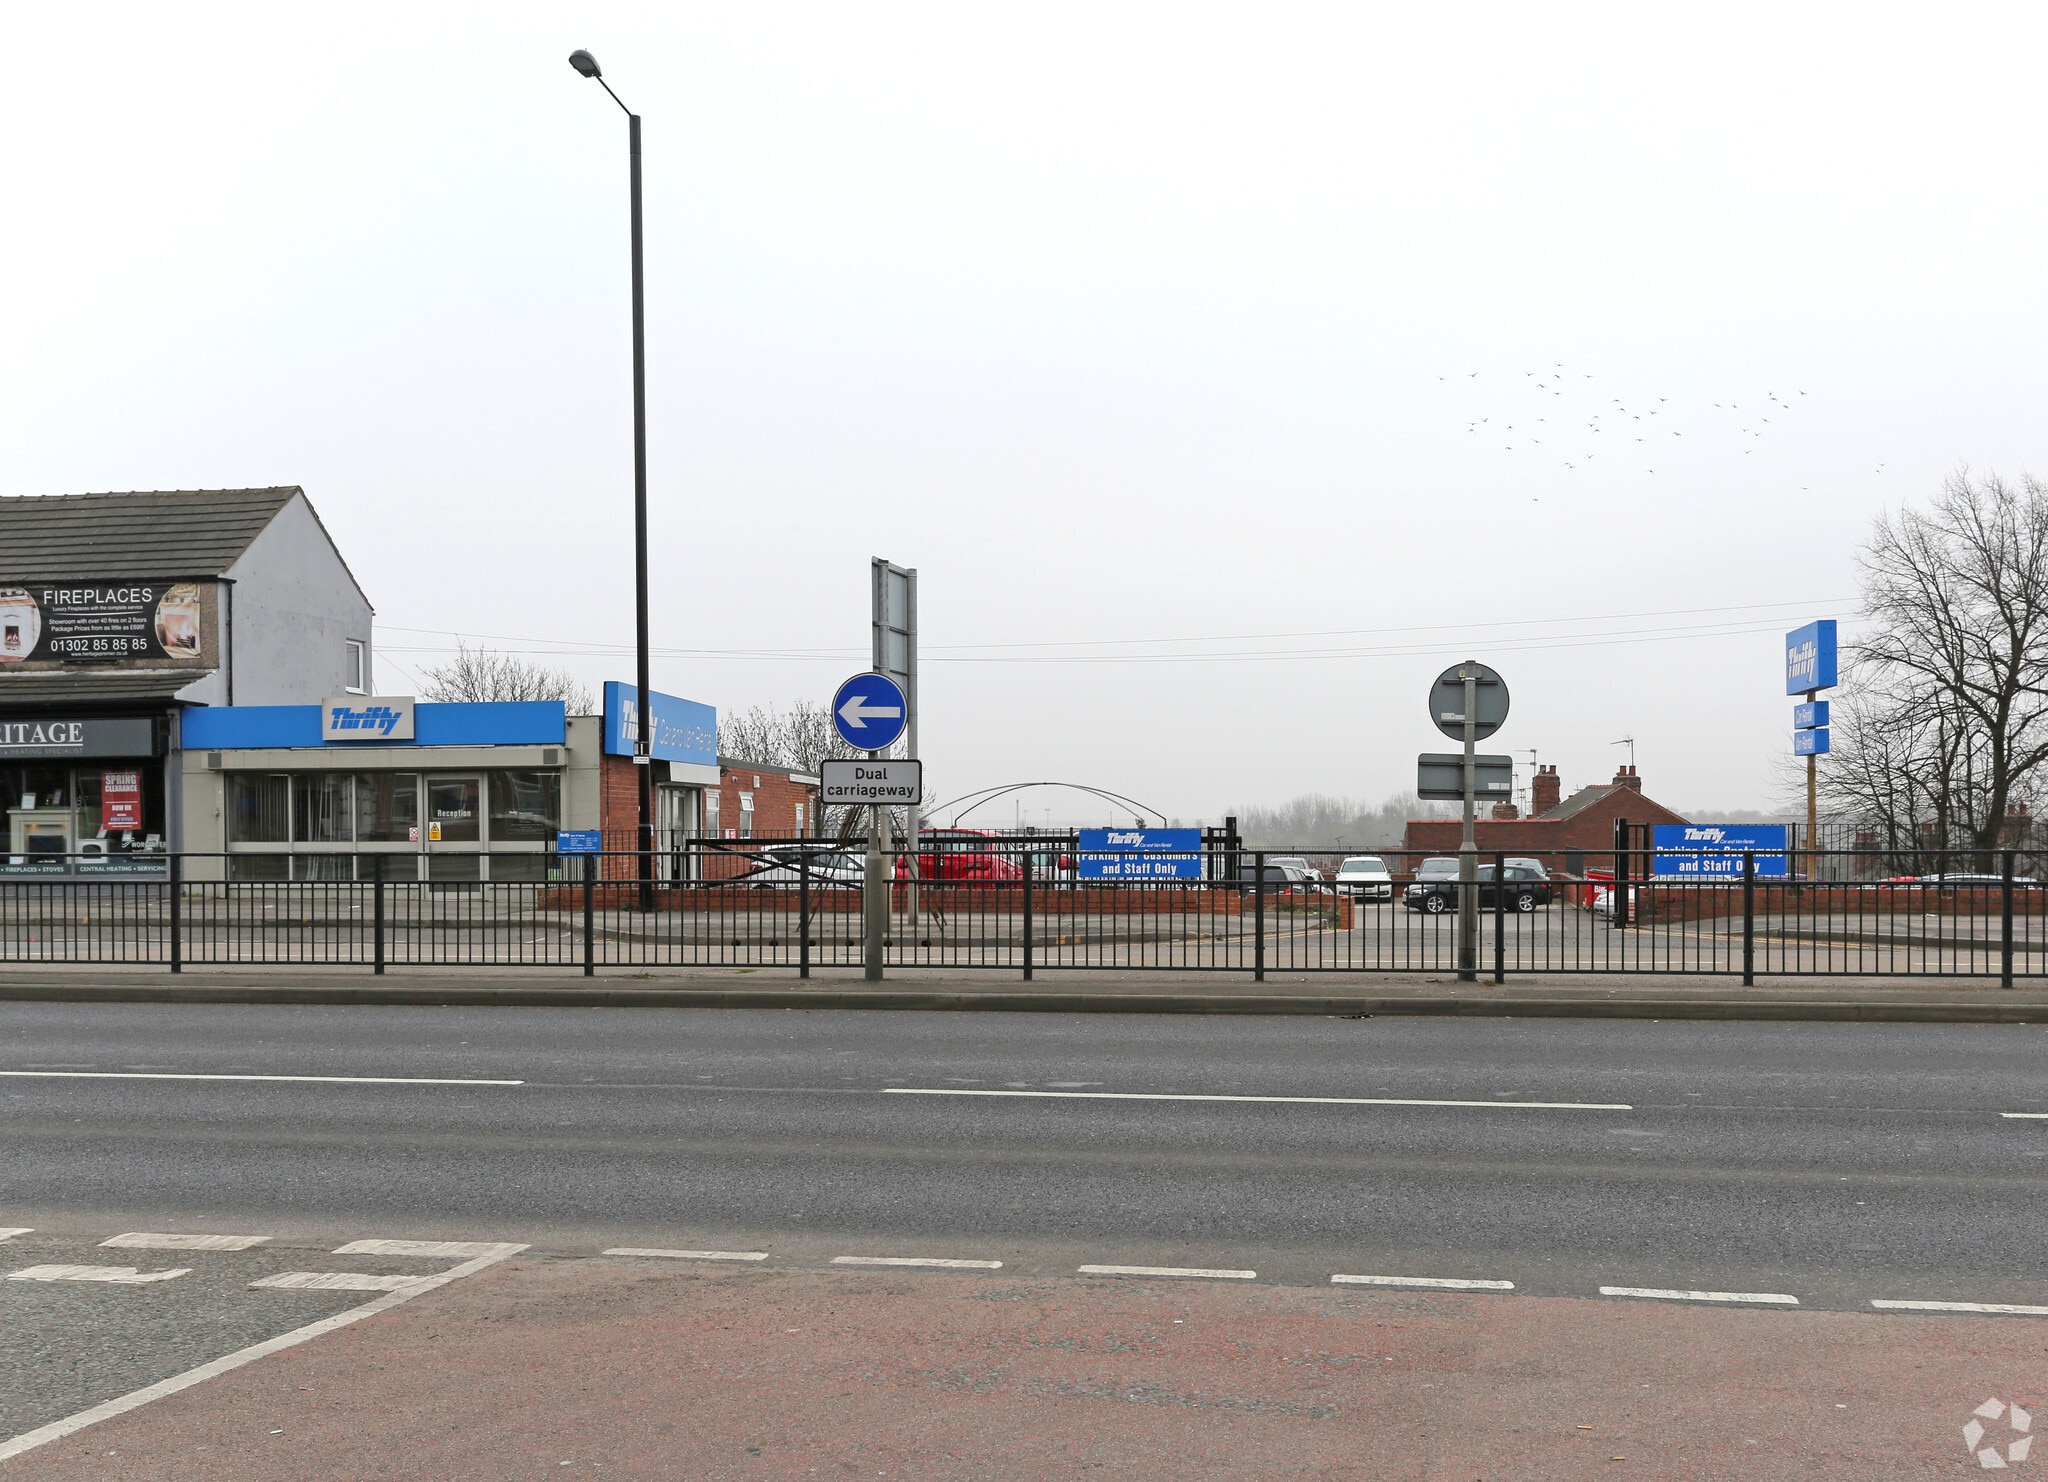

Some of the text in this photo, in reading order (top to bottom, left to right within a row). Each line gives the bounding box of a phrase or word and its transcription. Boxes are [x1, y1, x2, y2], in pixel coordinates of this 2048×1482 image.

[44, 588, 152, 604] FIREPLACES
[50, 639, 147, 651] 01302 85 85 85
[1789, 640, 1816, 682] Thrifty
[331, 707, 402, 735] Thrifty
[622, 700, 658, 755] Thty
[0, 723, 83, 743] ITAGE
[106, 775, 136, 785] SPRING
[855, 768, 888, 780] Dual
[827, 784, 914, 798] carriageway
[438, 810, 471, 818] Reception
[1107, 832, 1145, 847] Thrifty
[1684, 828, 1726, 844] Thrifty
[1081, 850, 1198, 862] Parking for Customers
[1656, 846, 1783, 859] Parking for Cusmers
[1102, 863, 1177, 875] and Staff Only
[1679, 860, 1760, 873] and Staff Oy
